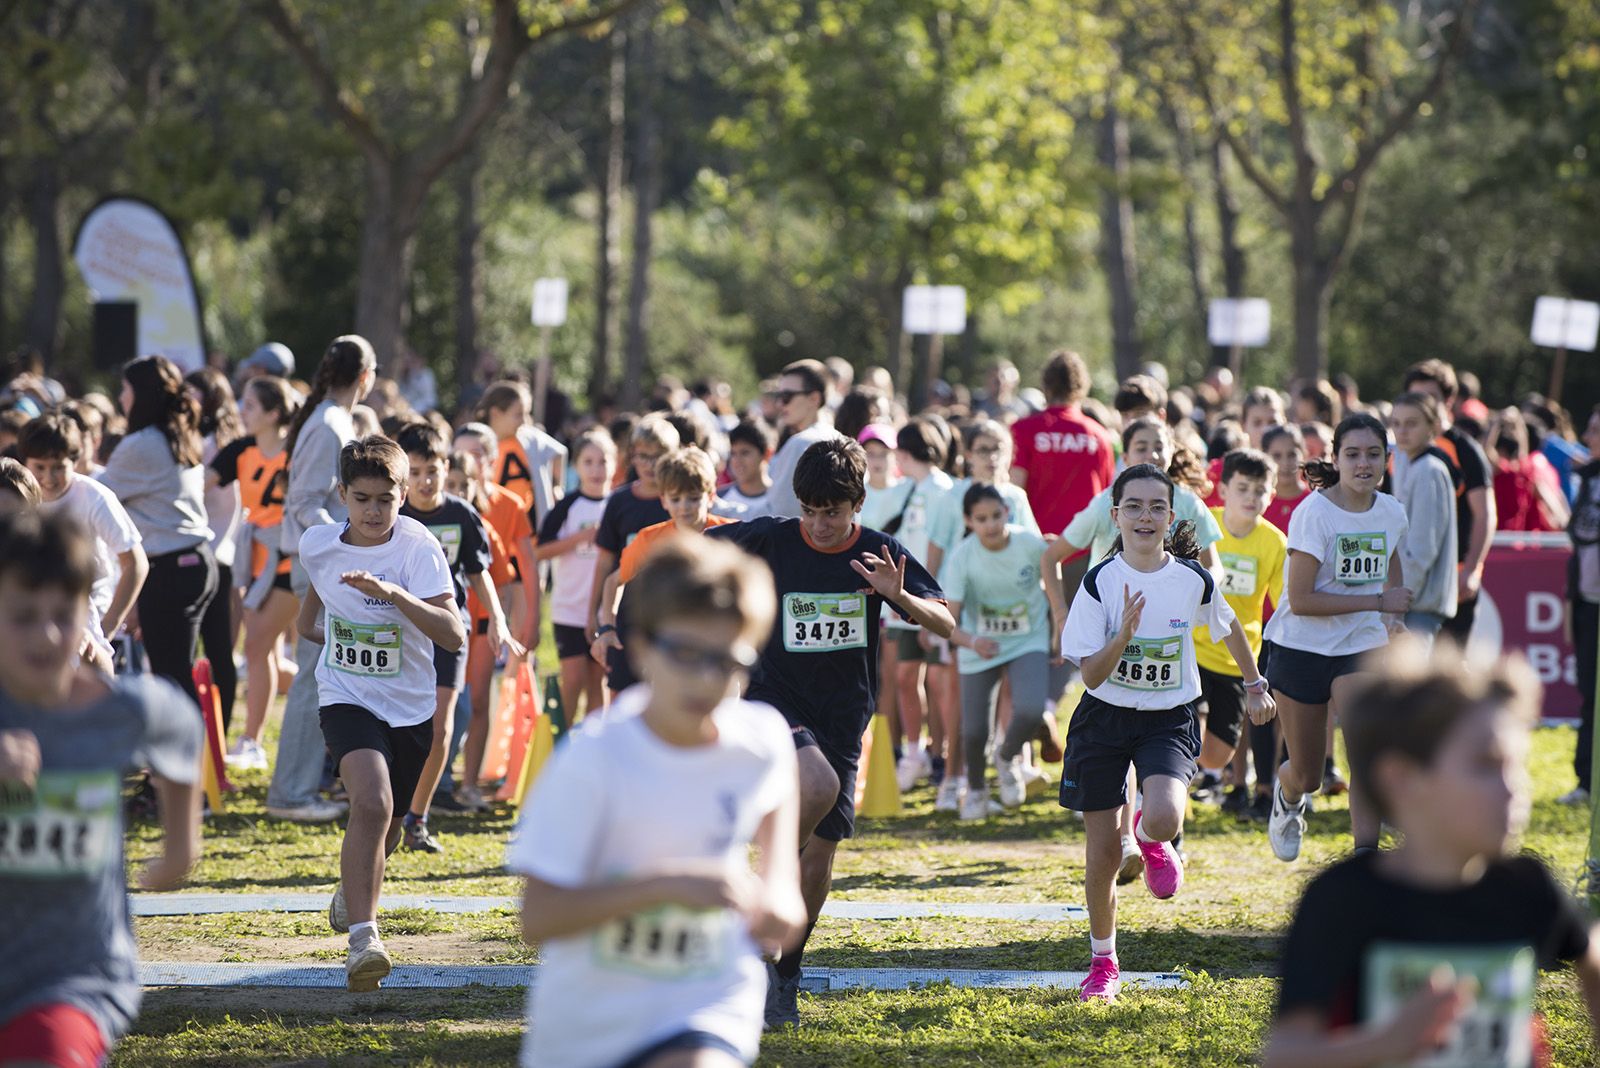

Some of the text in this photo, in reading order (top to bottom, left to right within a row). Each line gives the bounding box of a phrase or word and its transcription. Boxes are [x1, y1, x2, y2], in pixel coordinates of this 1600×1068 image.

[1034, 431, 1098, 455] STAFF
[1341, 556, 1379, 574] 3001
[792, 602, 816, 614] CROS
[795, 620, 850, 641] 3473
[335, 642, 388, 667] 3906
[1123, 644, 1141, 654] ROS
[1117, 659, 1171, 682] 4636
